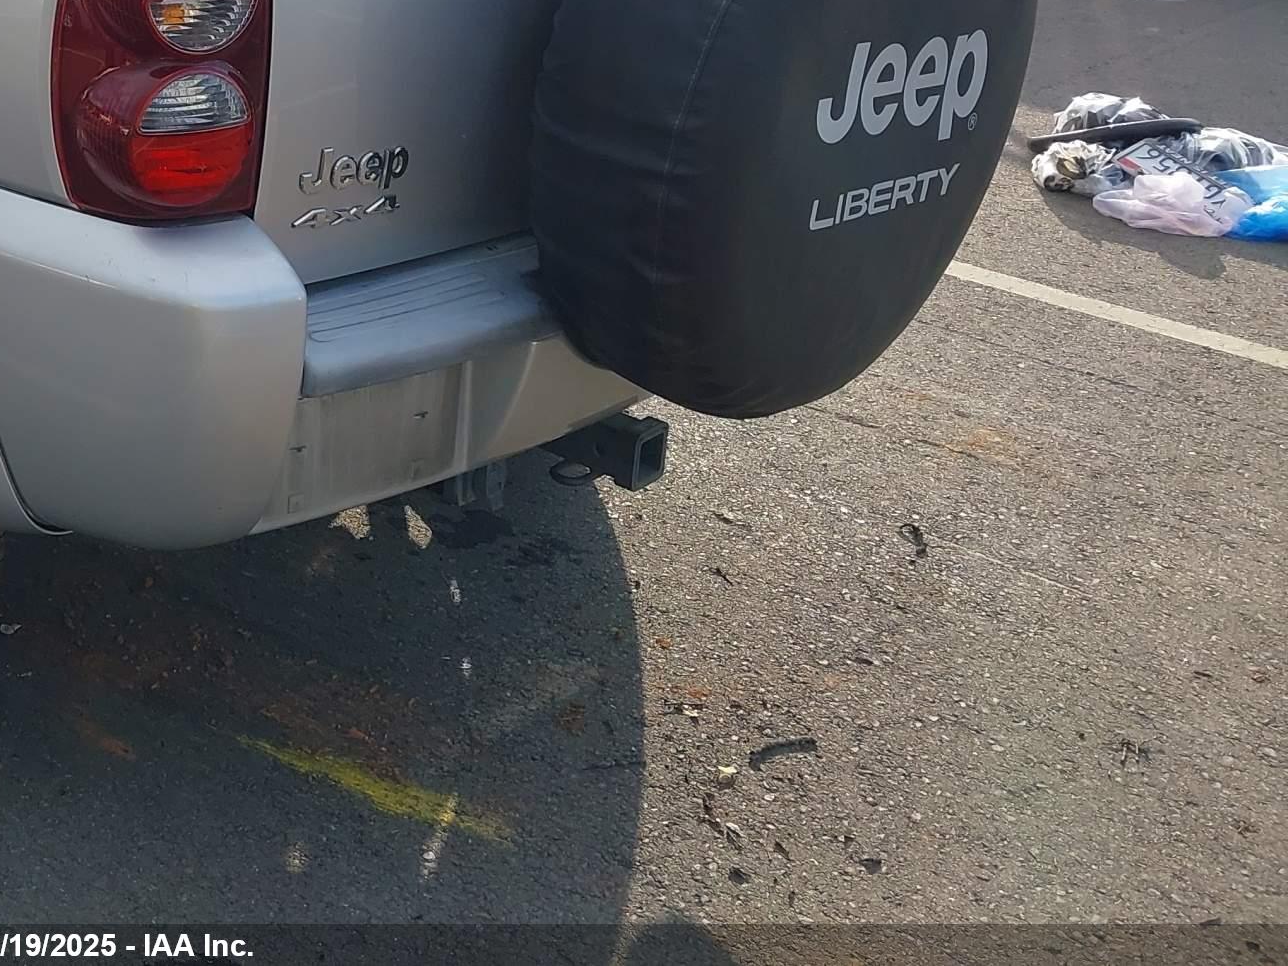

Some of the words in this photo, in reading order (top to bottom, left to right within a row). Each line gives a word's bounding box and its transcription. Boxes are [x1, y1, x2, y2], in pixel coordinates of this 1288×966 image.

[816, 29, 988, 145] Jeep
[299, 146, 410, 195] Jeep
[809, 163, 961, 231] LIBERTY
